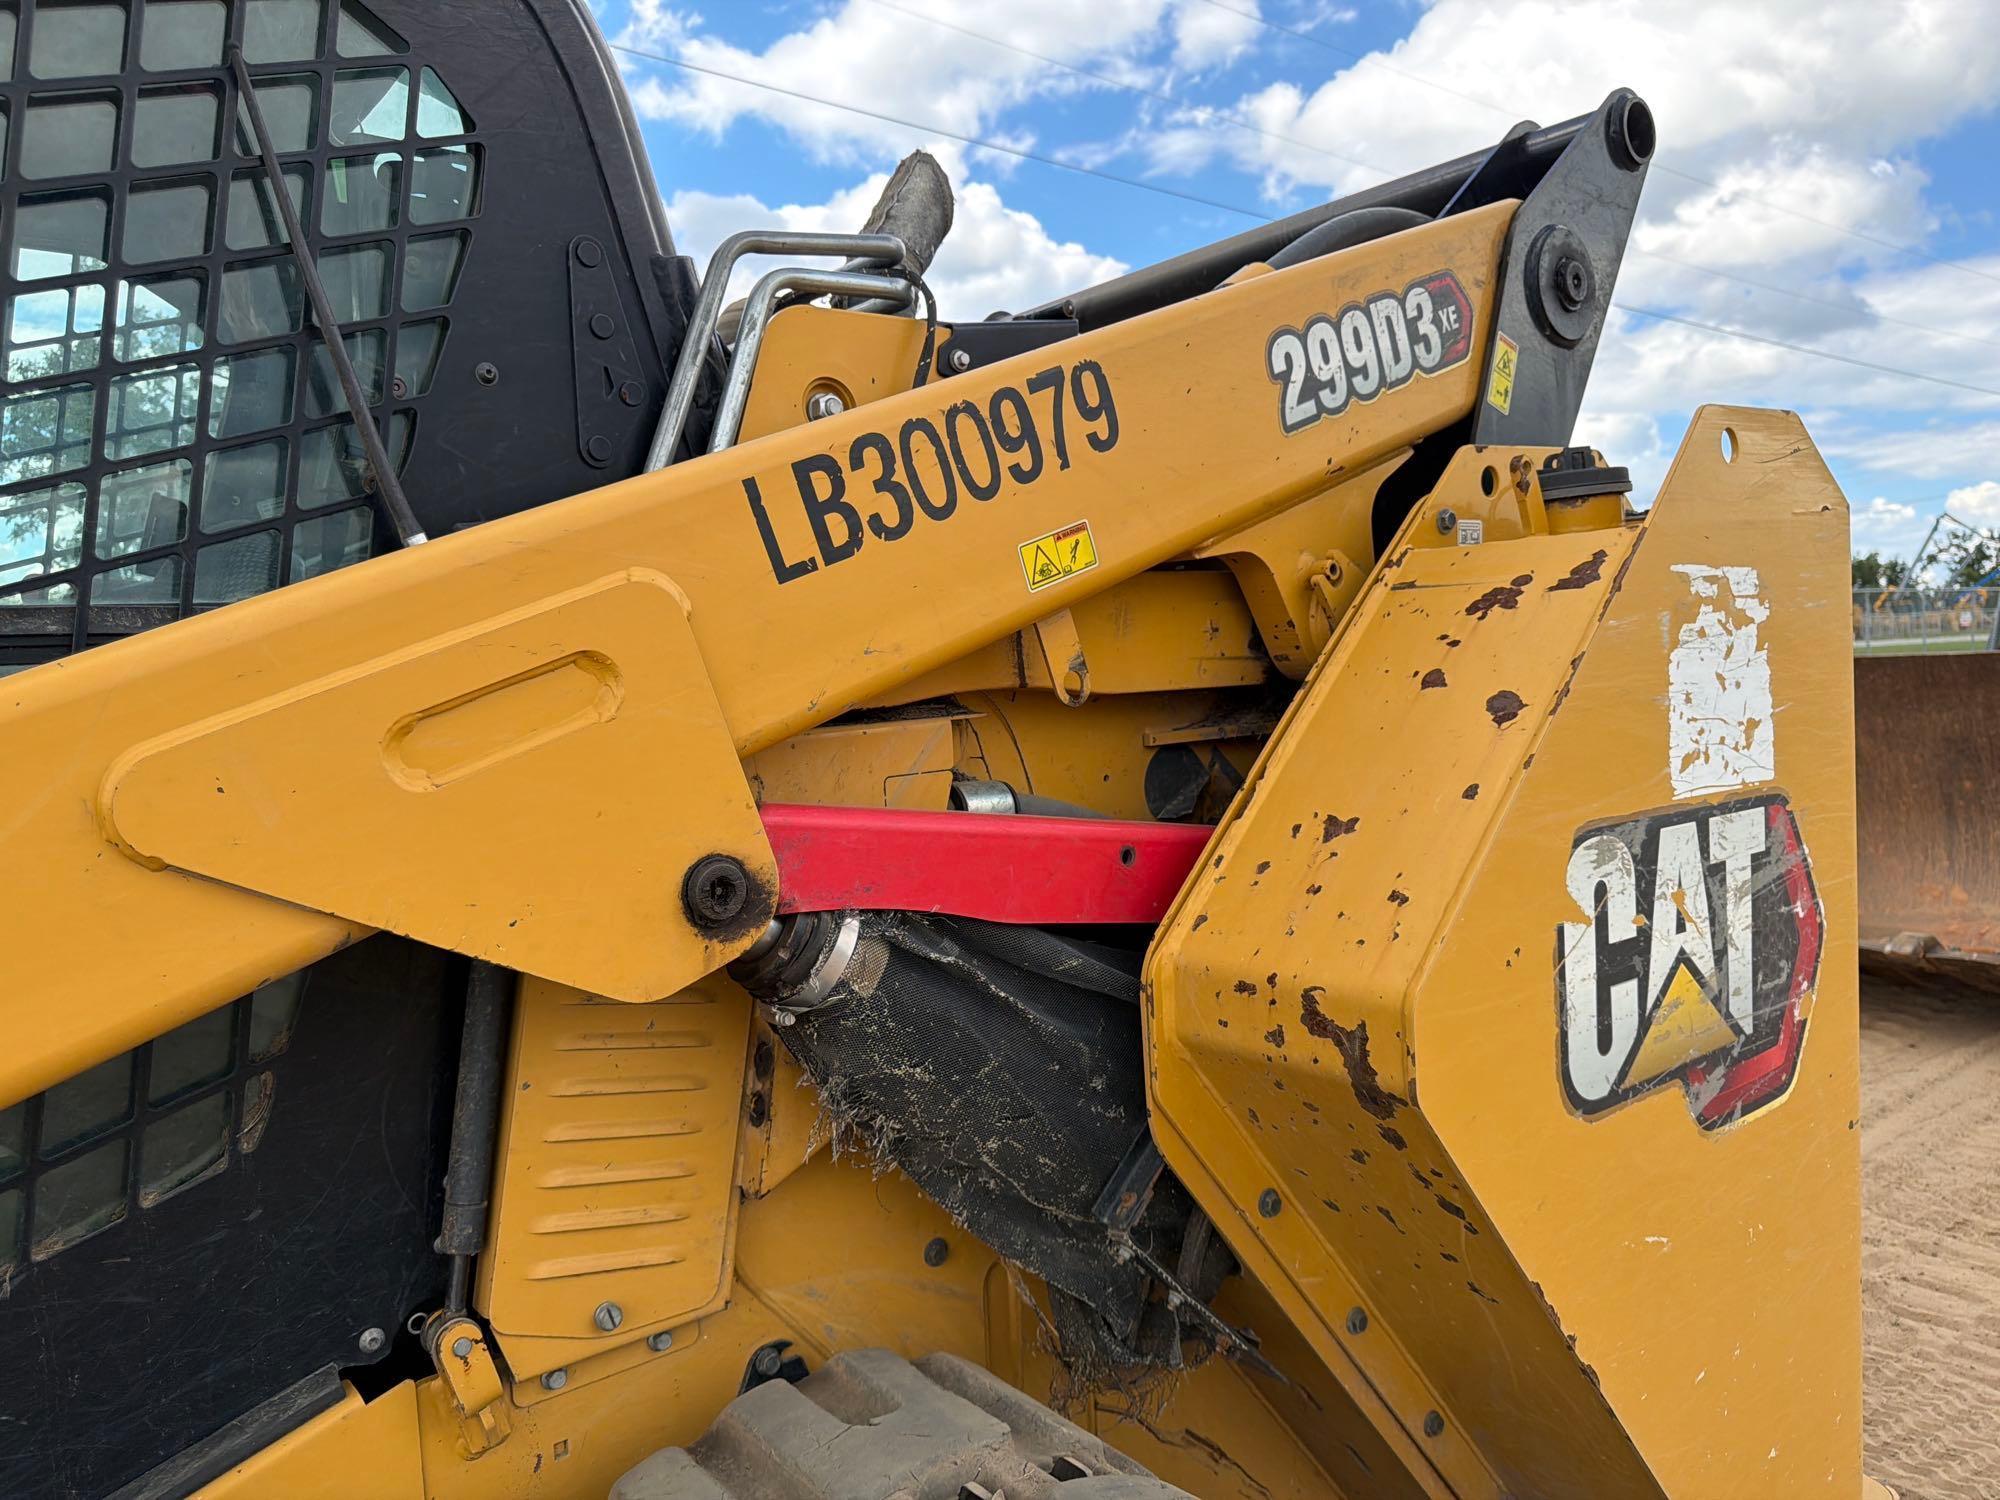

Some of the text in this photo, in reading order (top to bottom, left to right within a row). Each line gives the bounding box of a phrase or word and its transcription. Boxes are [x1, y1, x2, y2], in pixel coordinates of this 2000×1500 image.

[1271, 286, 1460, 426] 299D3 XE
[741, 358, 1120, 585] LB300979
[1062, 524, 1086, 538] WARNING
[1564, 805, 1767, 1101] CAT
